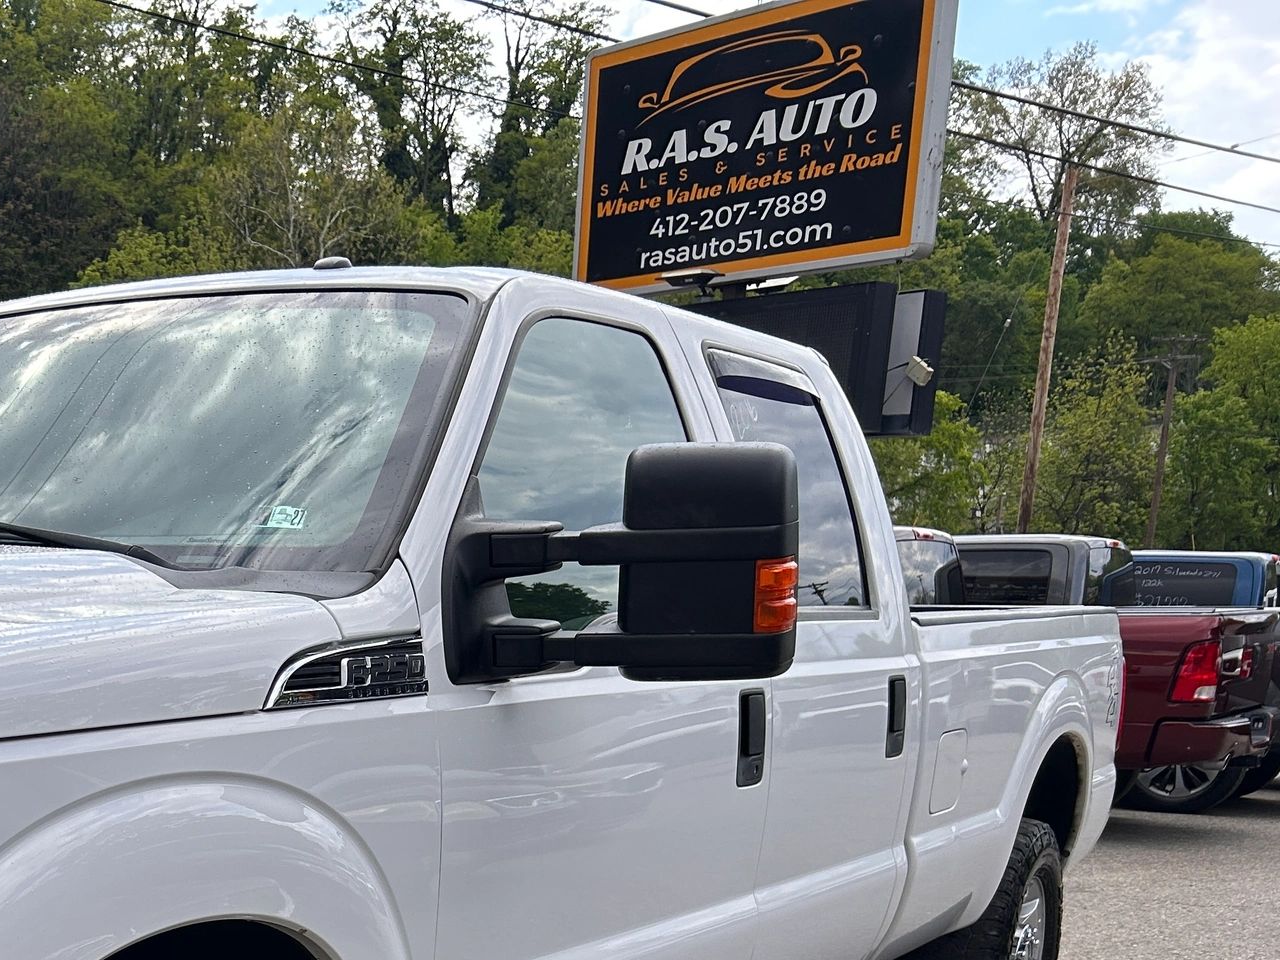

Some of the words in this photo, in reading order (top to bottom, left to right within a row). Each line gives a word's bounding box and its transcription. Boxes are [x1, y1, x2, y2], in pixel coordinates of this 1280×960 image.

[600, 168, 688, 197] SALES
[715, 160, 728, 174] &
[756, 124, 903, 167] SERVICE
[621, 119, 738, 175] R.A.S.
[745, 88, 878, 150] AUTO
[596, 191, 662, 219] Where
[665, 183, 723, 207] Value
[726, 164, 793, 195] Meets
[797, 158, 835, 182] the
[839, 142, 903, 173] Road
[648, 188, 828, 239] 412-207-7889
[639, 220, 833, 270] rasauto51.com
